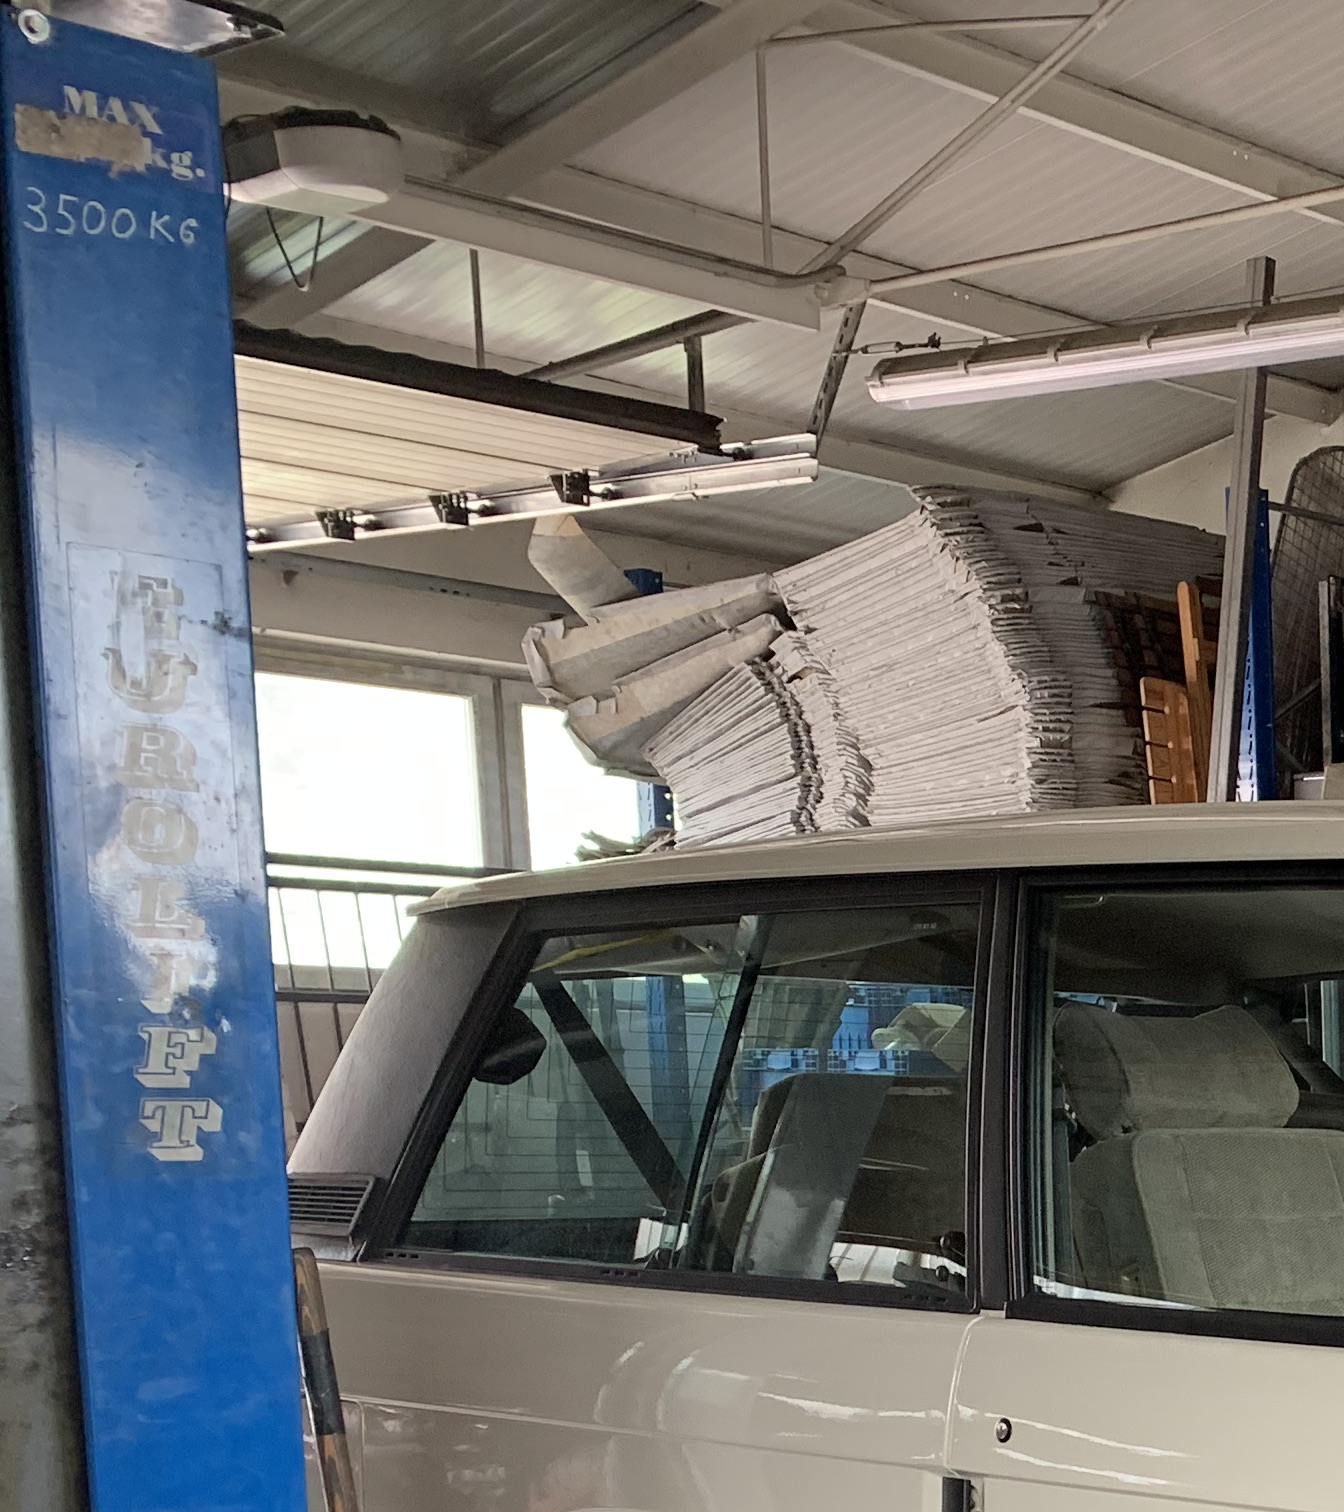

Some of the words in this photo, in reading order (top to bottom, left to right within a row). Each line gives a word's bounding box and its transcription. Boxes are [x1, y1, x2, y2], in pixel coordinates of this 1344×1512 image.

[63, 84, 164, 135] MAX
[23, 186, 137, 239] 3500
[149, 210, 199, 246] KG
